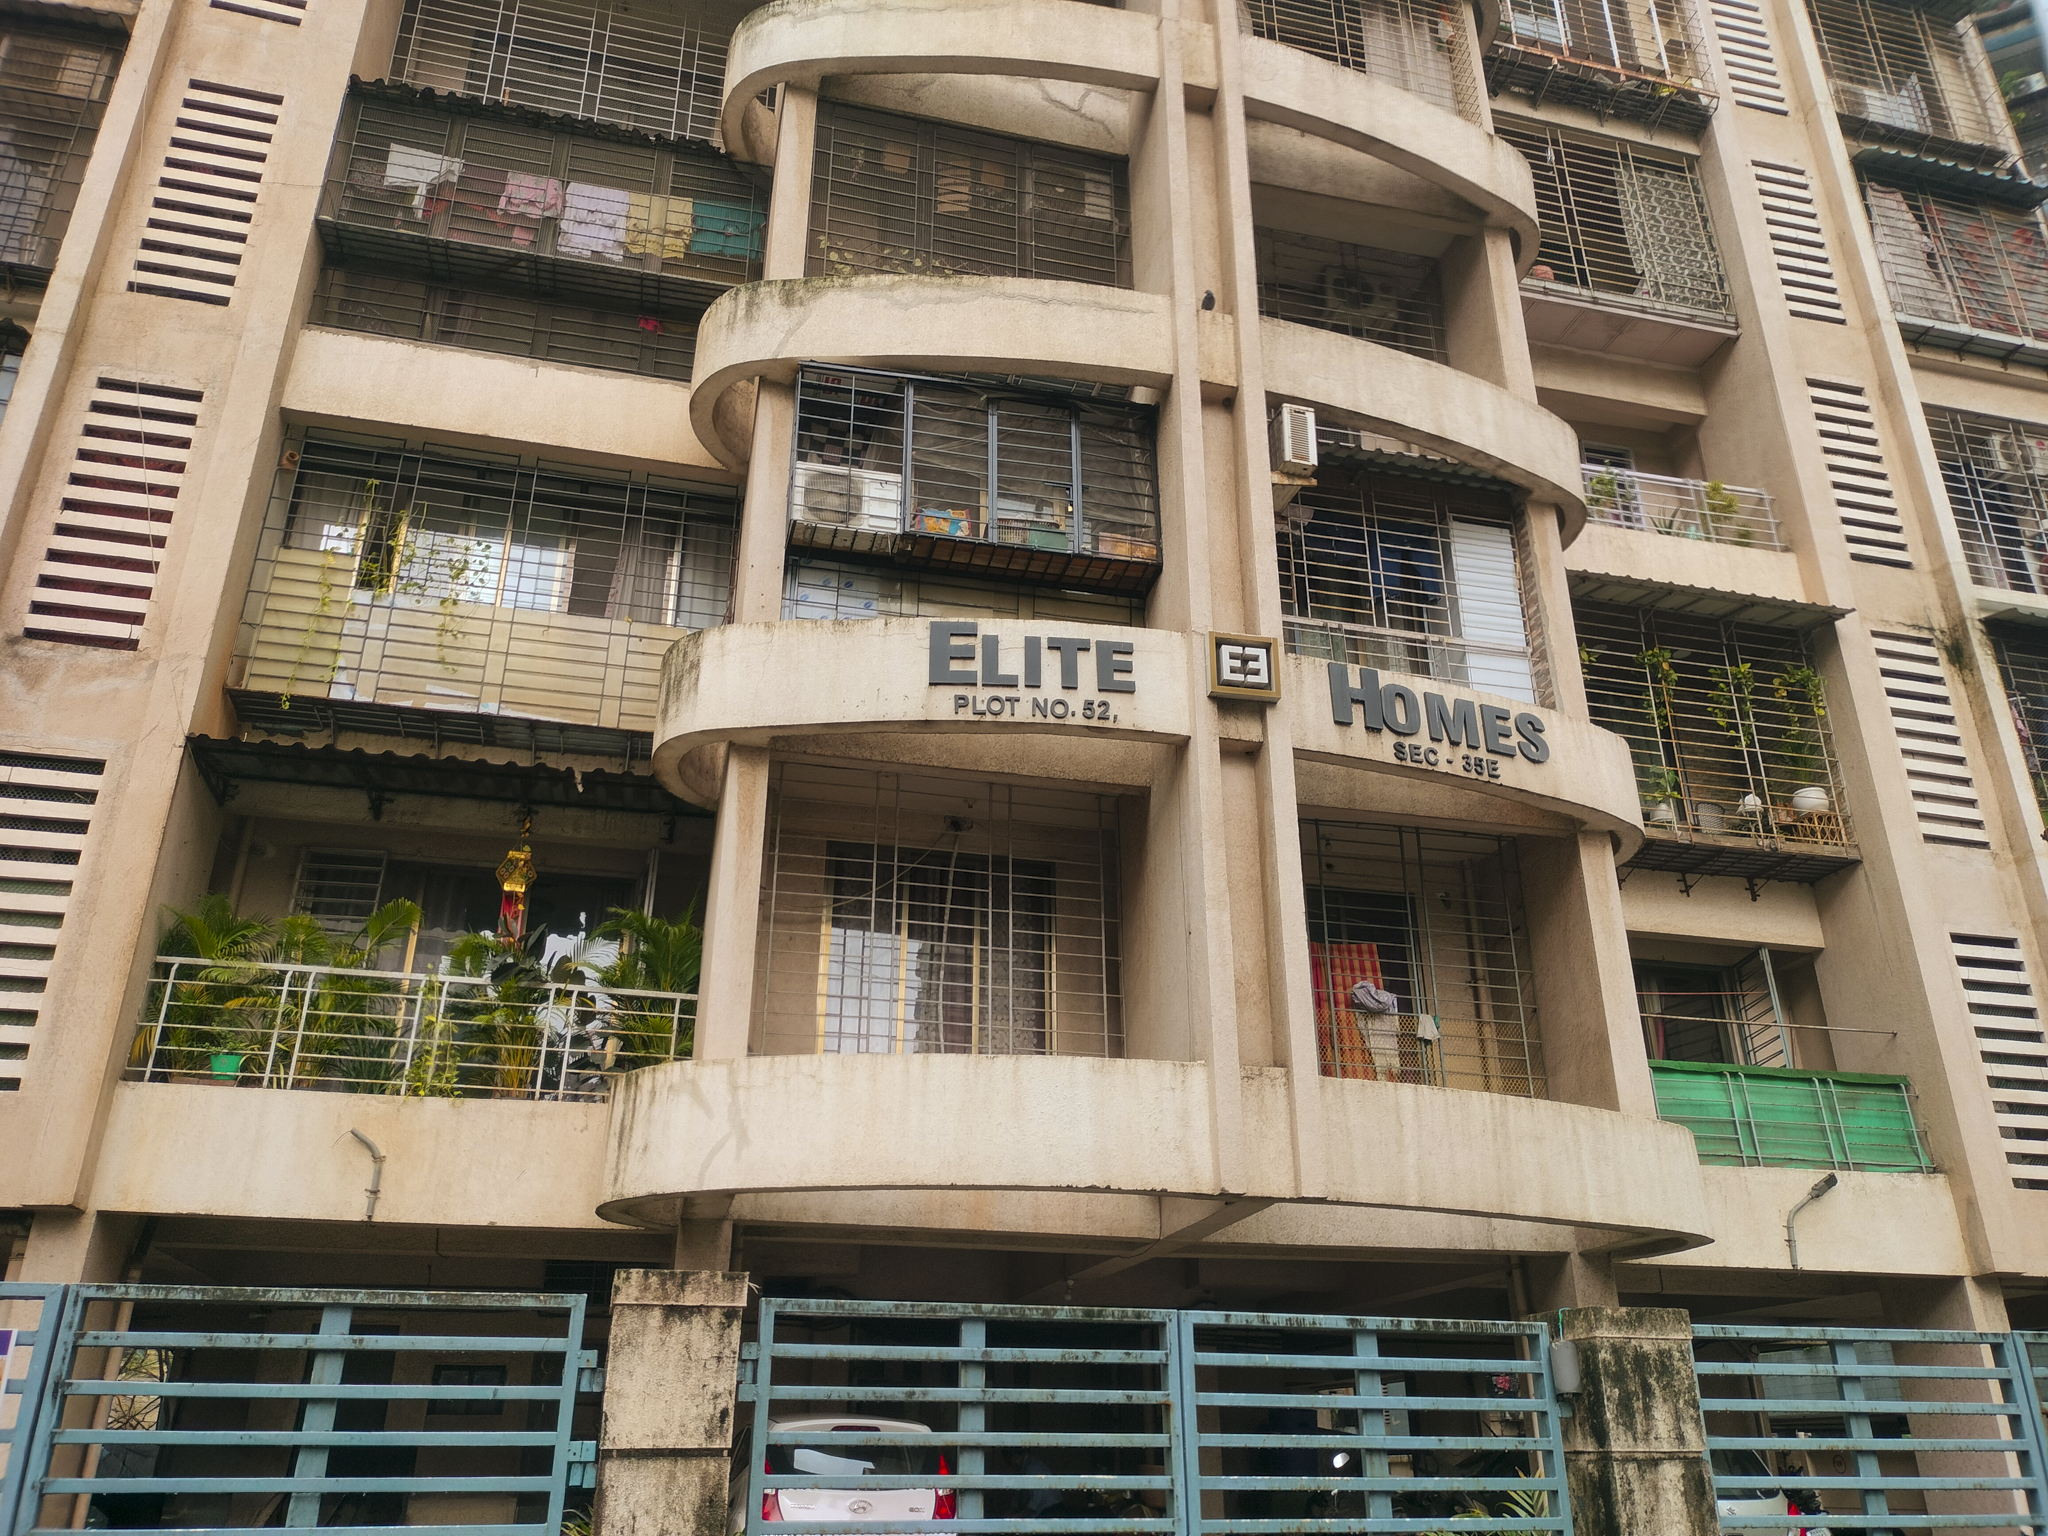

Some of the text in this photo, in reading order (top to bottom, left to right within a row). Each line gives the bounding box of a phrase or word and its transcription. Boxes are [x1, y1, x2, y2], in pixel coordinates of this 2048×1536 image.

[928, 620, 1136, 693] ELITE
[954, 694, 1119, 723] PLOT NO. 52,
[1328, 662, 1550, 763] HOMES
[1392, 741, 1439, 766] SEC
[1461, 753, 1501, 779] 35E
